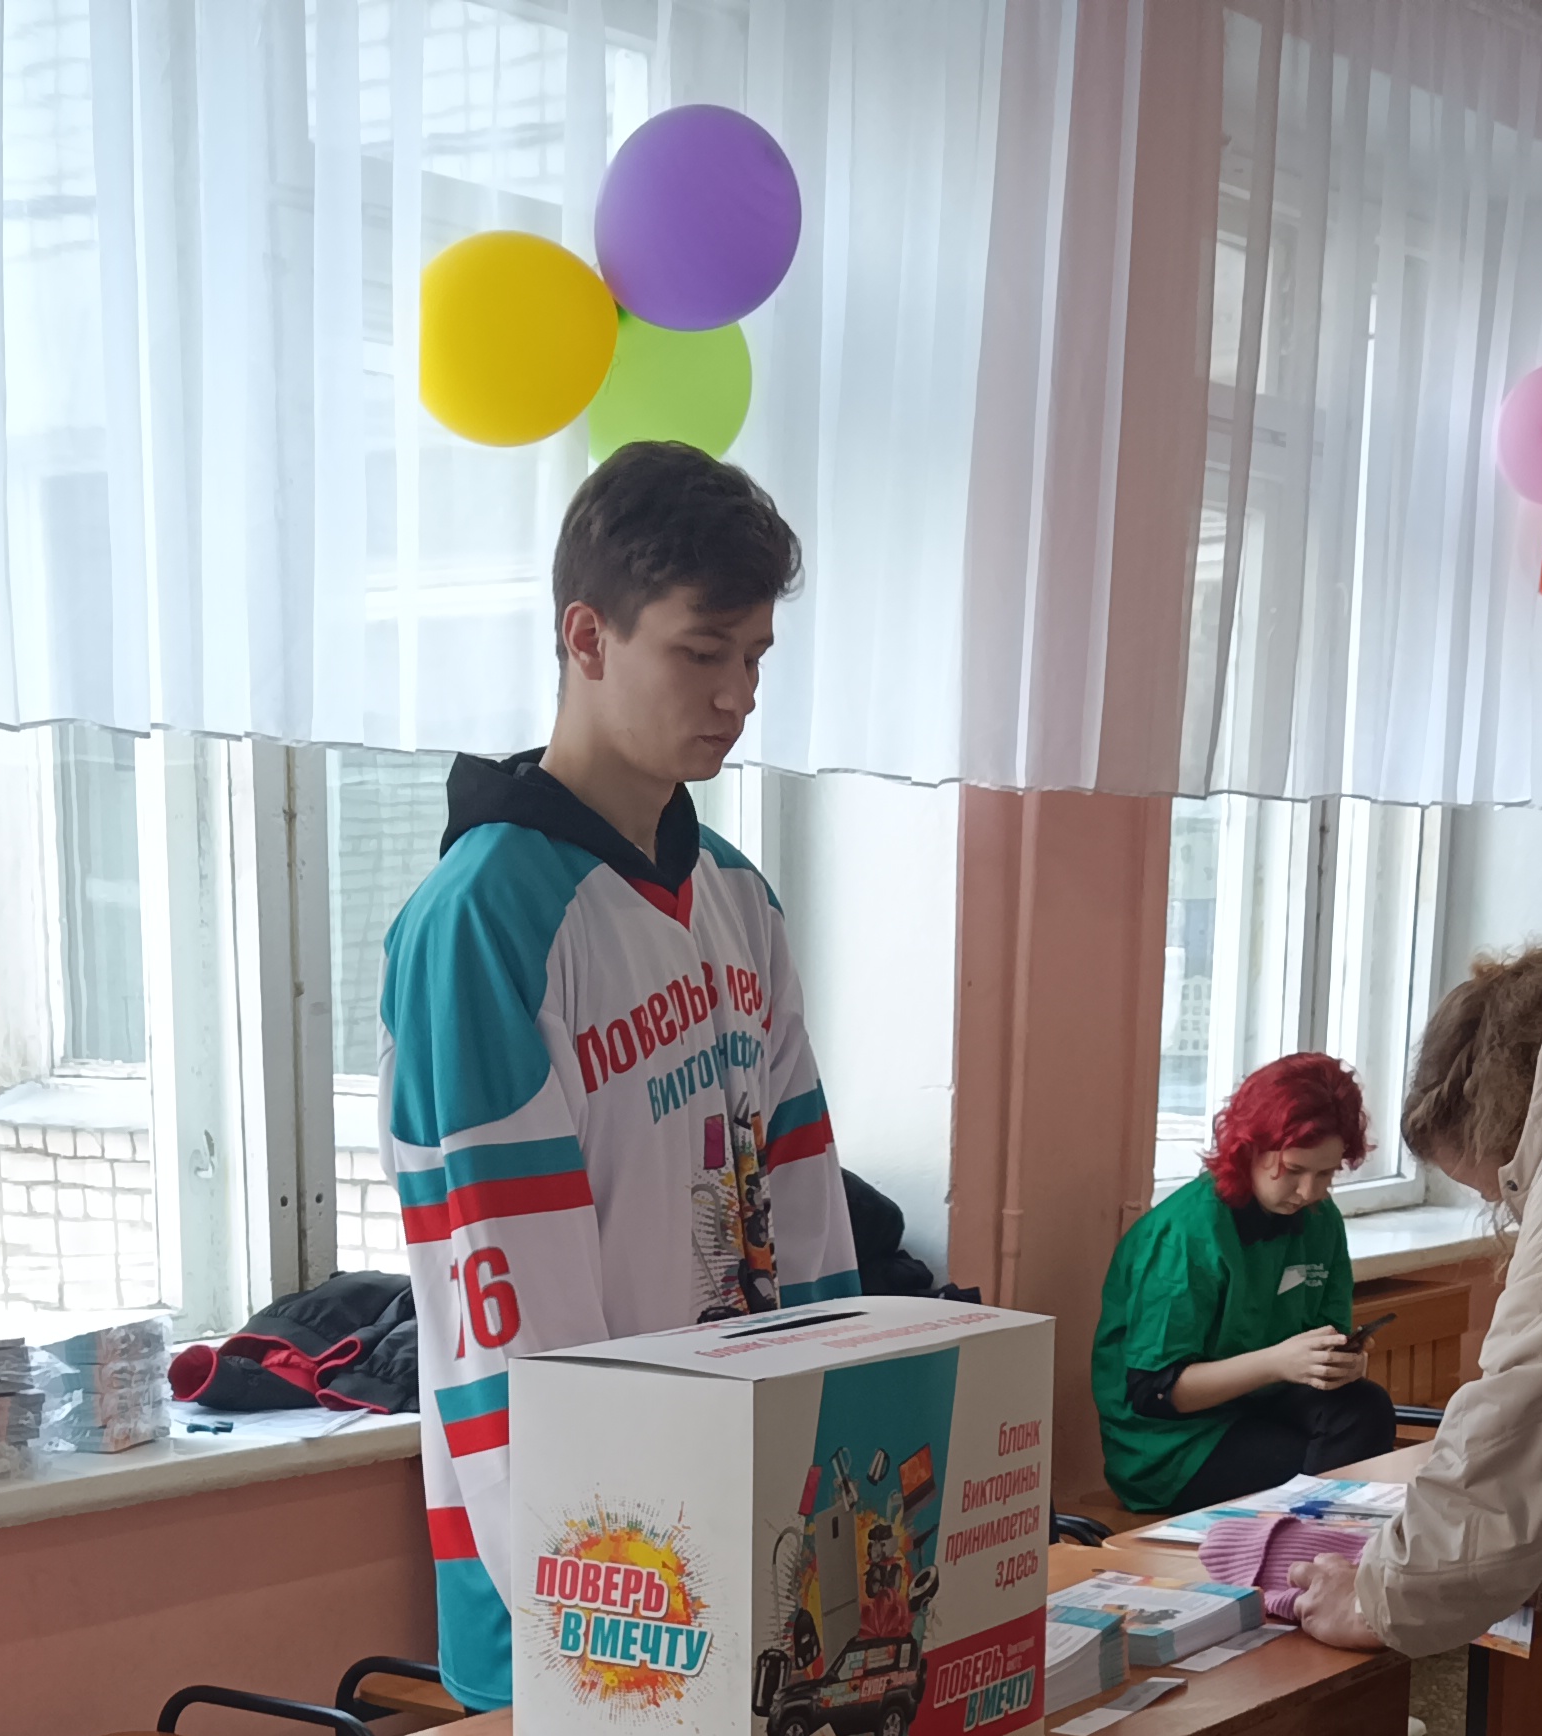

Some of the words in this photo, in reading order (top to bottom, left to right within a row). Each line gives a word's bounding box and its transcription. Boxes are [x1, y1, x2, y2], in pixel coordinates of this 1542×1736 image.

[450, 1246, 522, 1360] 6
[997, 1419, 1043, 1457] бланк
[961, 1461, 1042, 1514] Викторины
[944, 1504, 1041, 1564] принимается
[534, 1555, 667, 1614] ПОВЕРЬ
[994, 1547, 1039, 1592] здесь
[559, 1610, 585, 1654] В
[590, 1615, 709, 1673] МЕЧТУ
[934, 1646, 1004, 1708] ПОВЕРЬ
[963, 1687, 979, 1732] В
[979, 1666, 1036, 1726] МЕЧТУ
